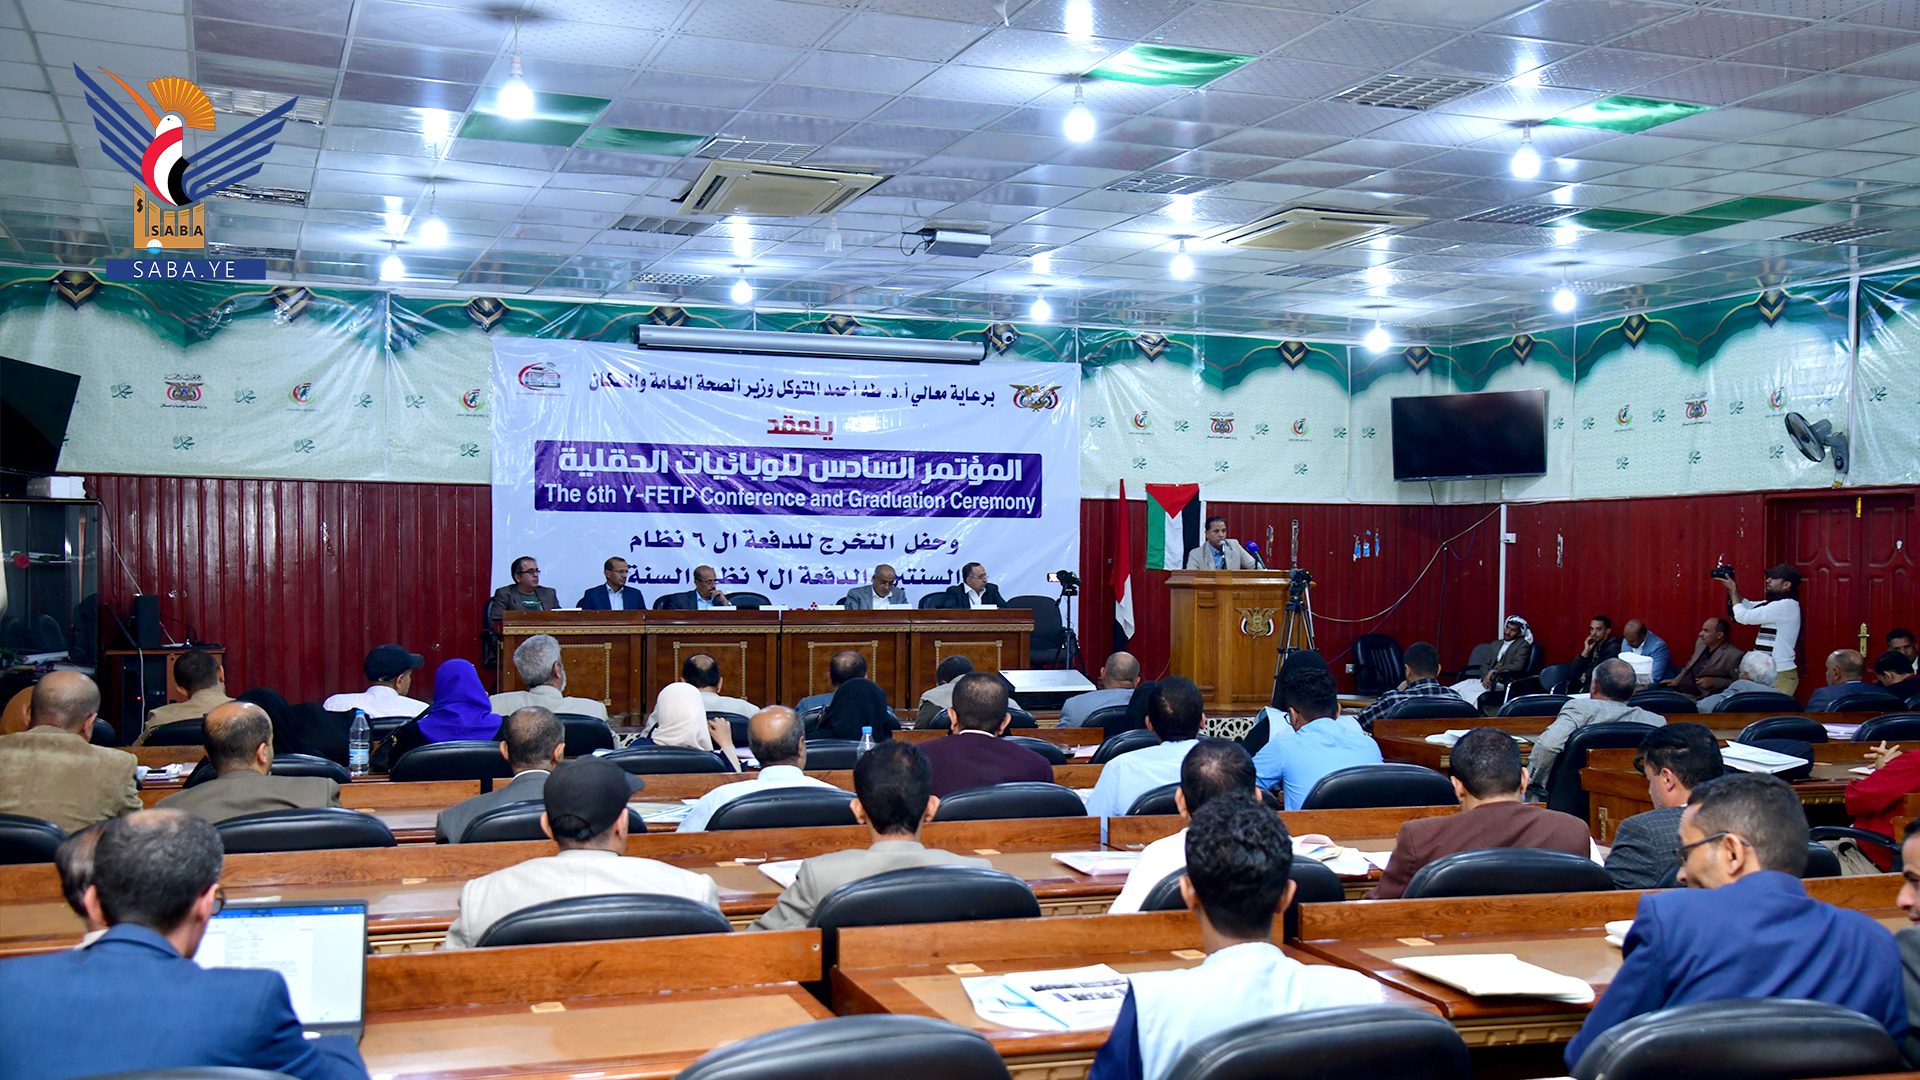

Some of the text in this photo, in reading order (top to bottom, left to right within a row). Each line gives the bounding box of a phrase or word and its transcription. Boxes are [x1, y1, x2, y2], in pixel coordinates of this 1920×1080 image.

[650, 371, 693, 391] العامة
[696, 373, 740, 392] الصحة
[743, 377, 774, 399] وزير
[776, 379, 820, 399] المتوكل
[824, 380, 856, 397] أحمد
[861, 383, 881, 398] طه
[911, 385, 947, 407] معالي
[950, 384, 995, 407] برعاية
[767, 415, 834, 441] ينعقد
[558, 447, 1022, 486] المؤتمر السادس للوبائيات الحقلية
[543, 483, 1036, 515] The 6th Y-FETP Conference and Graduation Ceremony
[629, 529, 959, 555] وحفل التخرج للدفعة ال ٦ نظام
[628, 564, 690, 585] السنة
[714, 566, 750, 585] نظ
[798, 565, 873, 586] الدفعة
[894, 567, 960, 591] السنتي
